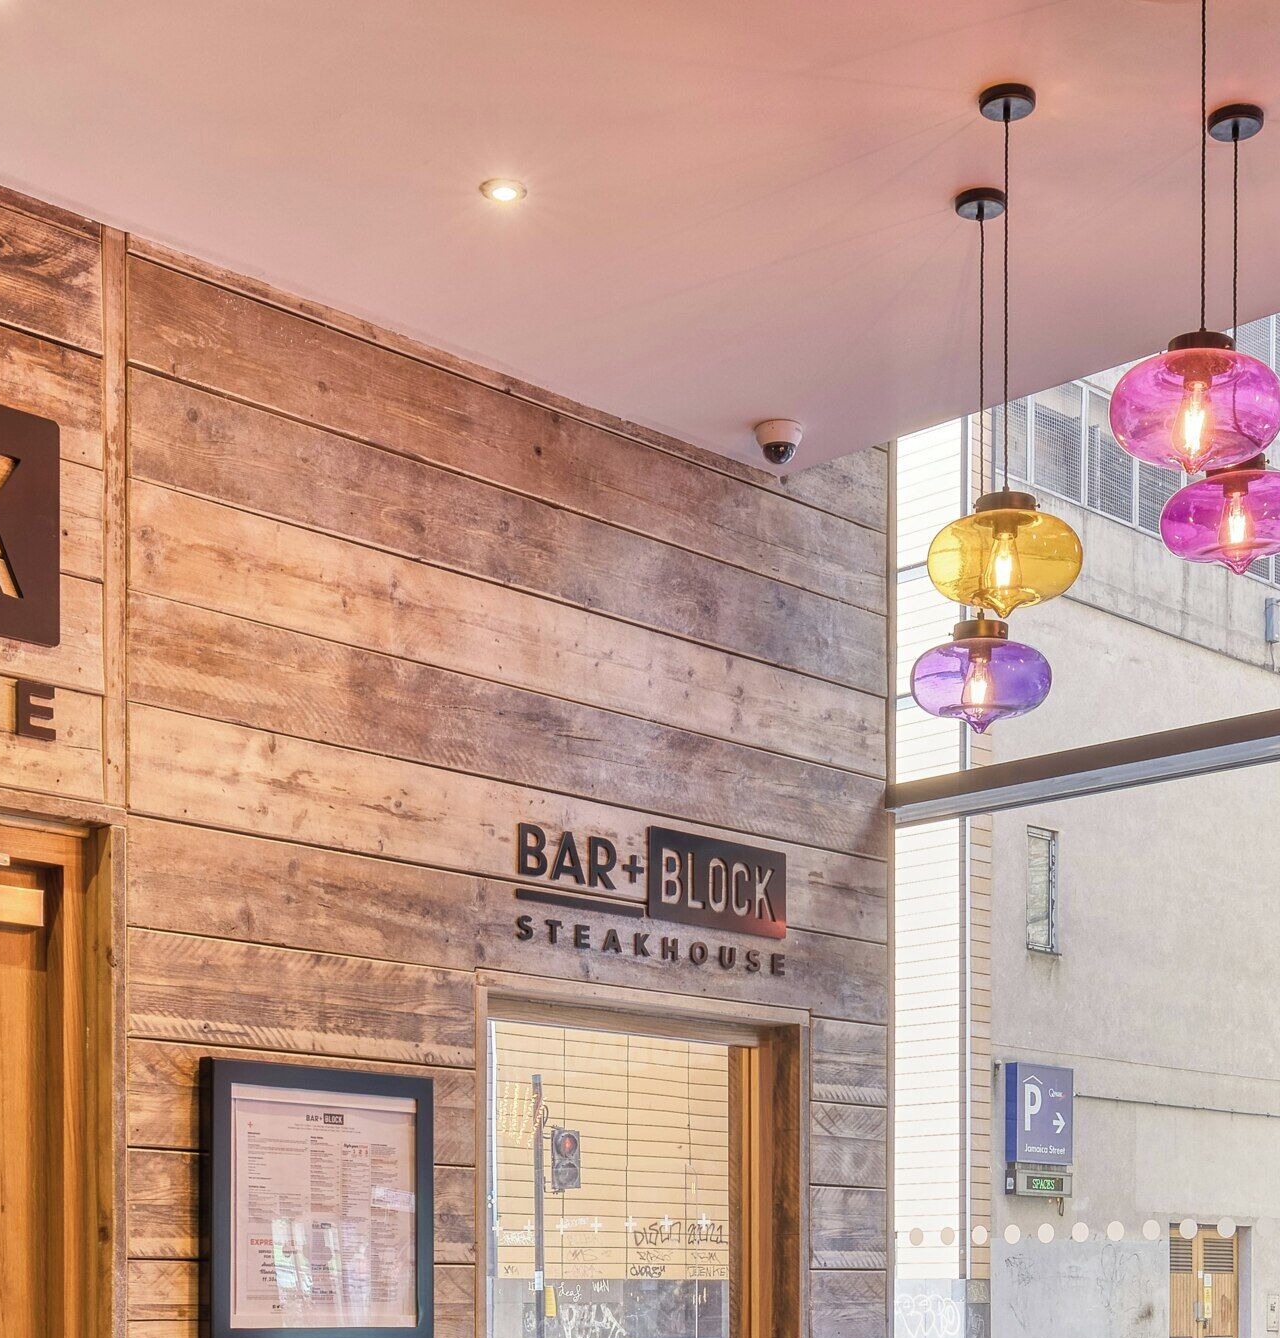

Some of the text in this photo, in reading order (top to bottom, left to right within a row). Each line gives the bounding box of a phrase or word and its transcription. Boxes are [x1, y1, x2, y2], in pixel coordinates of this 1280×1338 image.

[662, 847, 776, 923] BLOCK
[516, 915, 786, 977] STEAKHOUSE
[1024, 1083, 1042, 1131] P
[1024, 1144, 1066, 1155] Jamaica Street
[1032, 1178, 1055, 1190] SPACES
